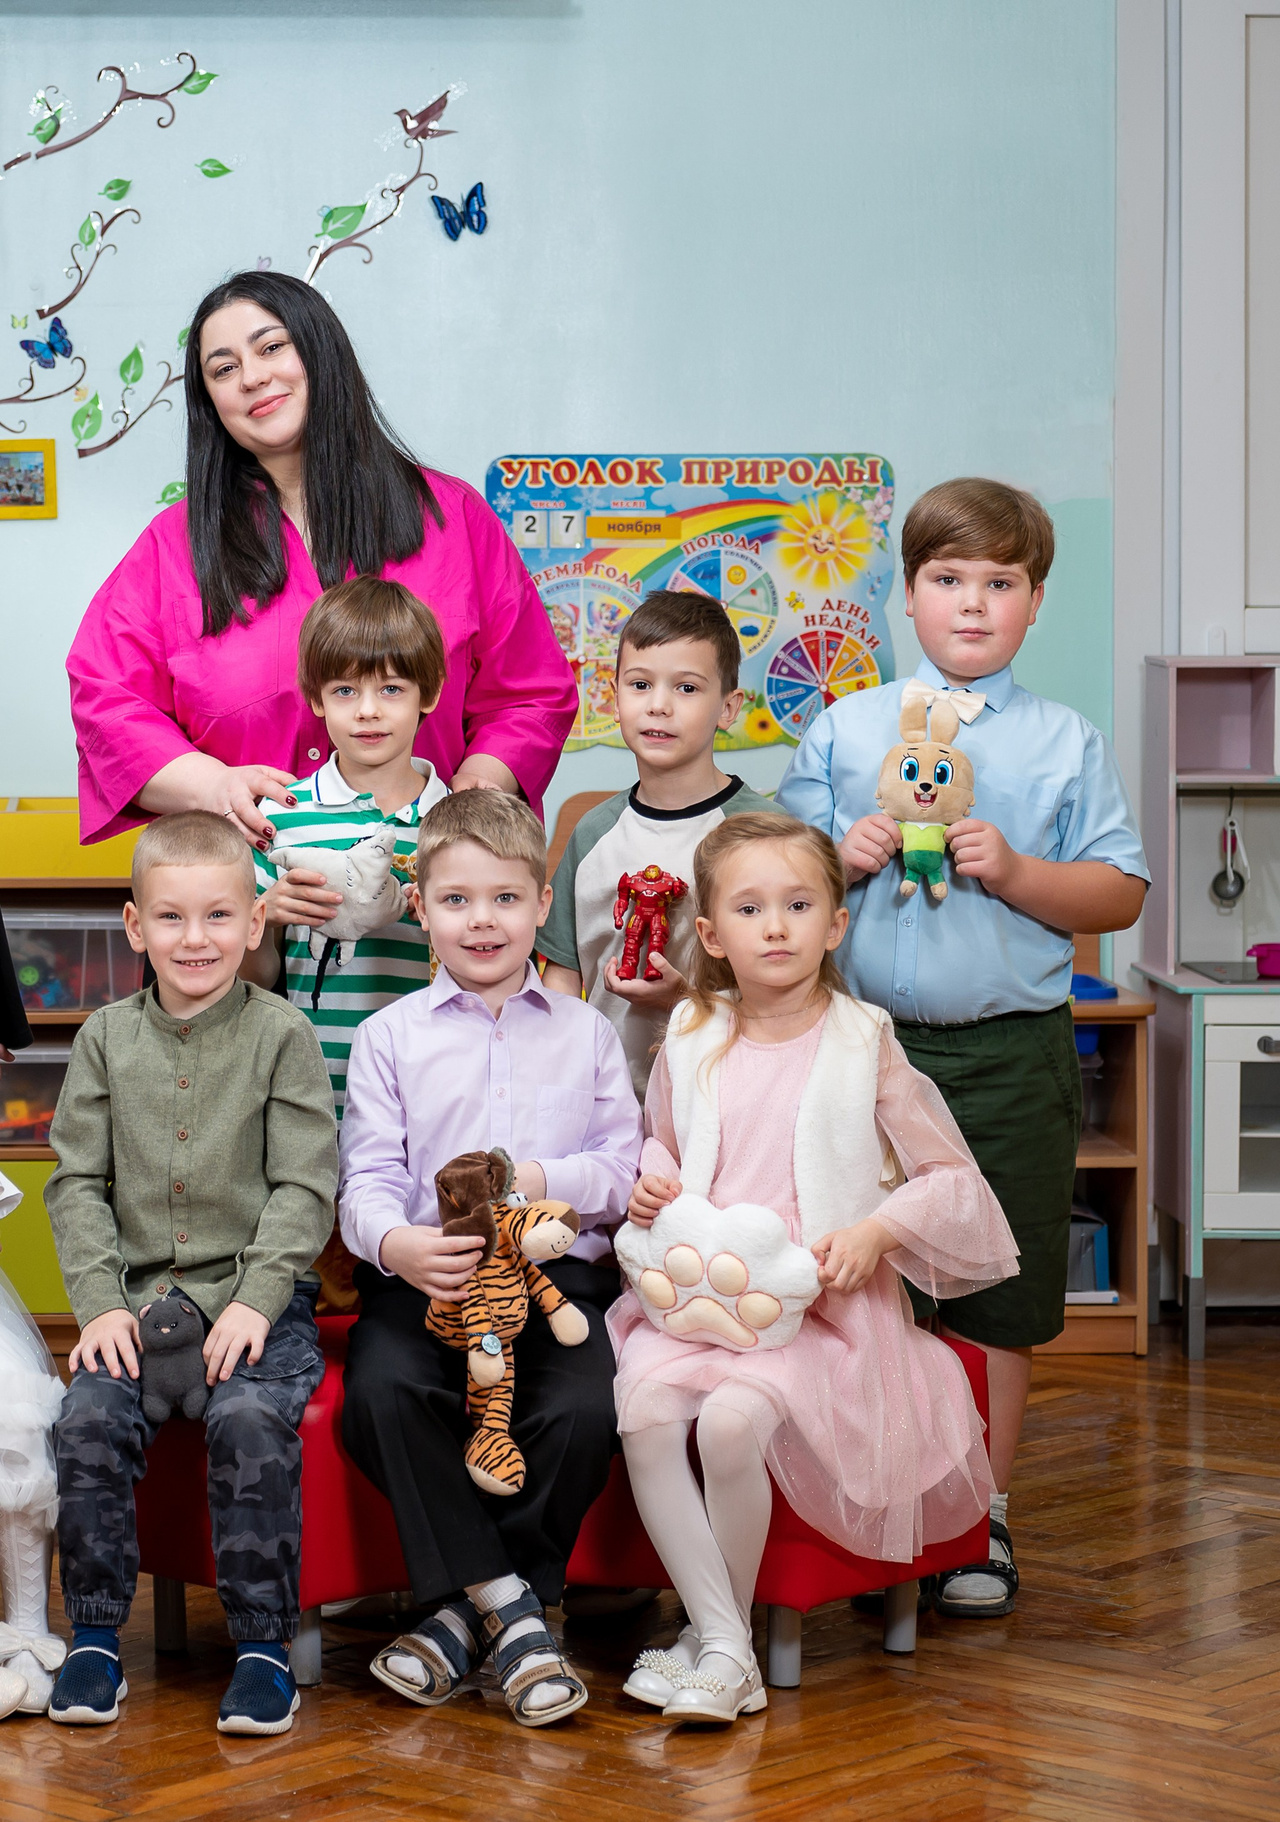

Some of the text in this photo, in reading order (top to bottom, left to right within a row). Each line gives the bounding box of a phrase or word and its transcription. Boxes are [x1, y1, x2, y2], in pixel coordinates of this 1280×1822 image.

[500, 459, 882, 488] УГОЛОК ПРИРОДЫ
[611, 500, 646, 508] МЕСЯЦ
[524, 515, 575, 533] 2 7
[607, 520, 662, 535] ноября
[682, 533, 761, 556] ПОГОДА
[533, 562, 584, 588] РЕМЯ
[593, 562, 643, 594] ГОДА
[821, 598, 871, 624] ДЕНЬ
[803, 614, 881, 650] НЕДЕЛИ
